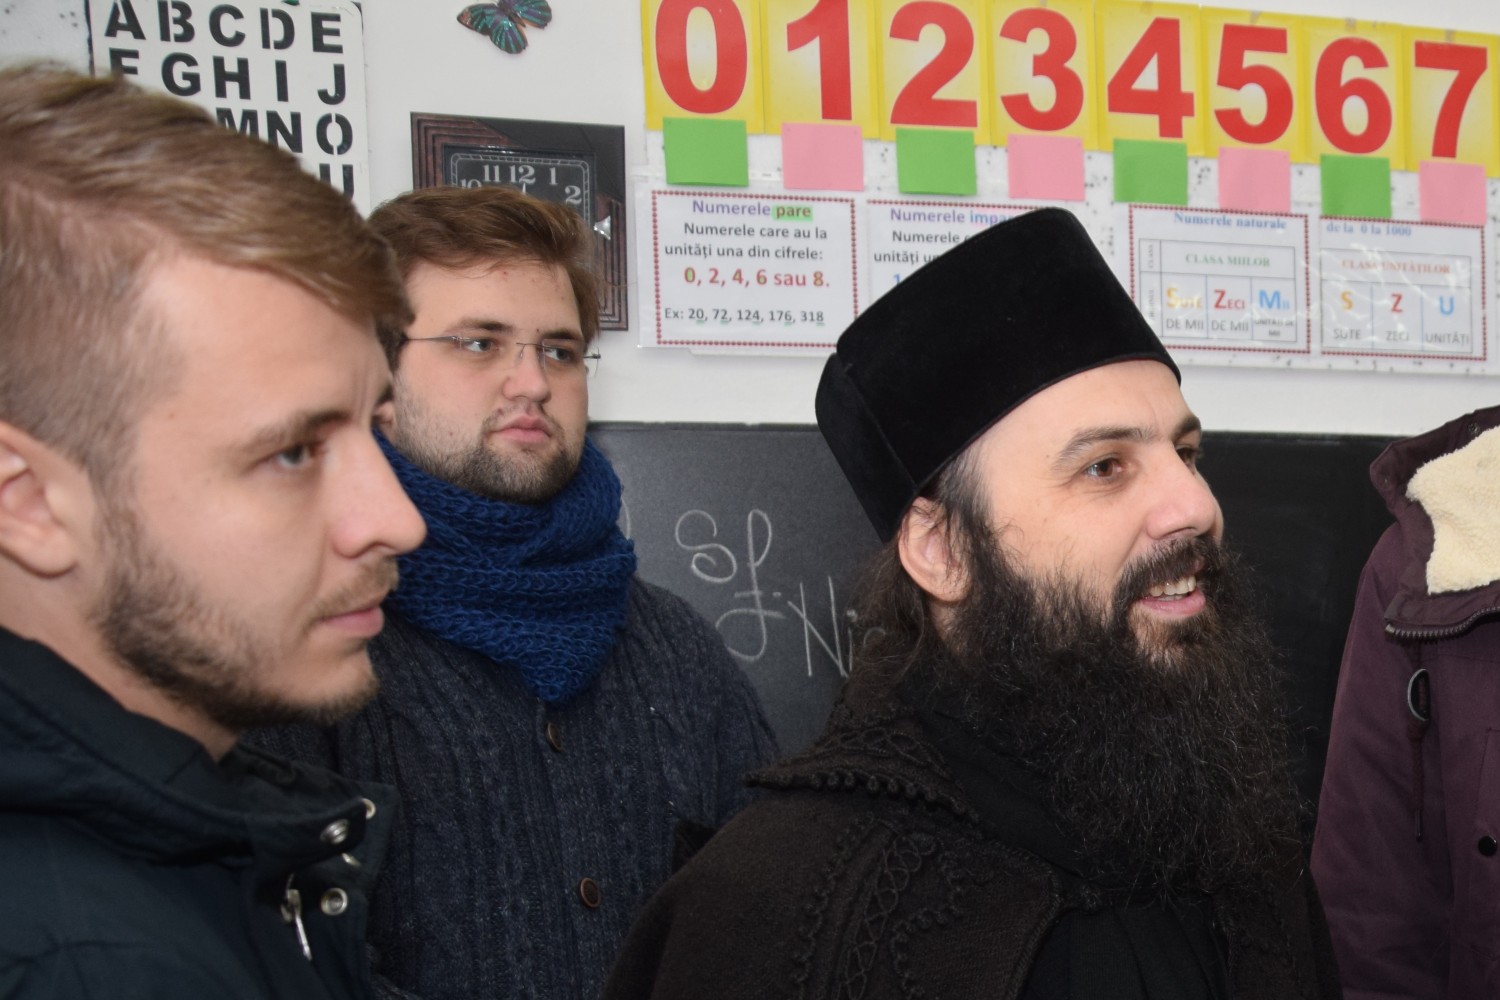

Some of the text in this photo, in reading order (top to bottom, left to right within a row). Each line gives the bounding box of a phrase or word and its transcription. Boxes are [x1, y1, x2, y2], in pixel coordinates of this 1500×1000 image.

[104, 0, 343, 54] A B C D E
[161, 52, 201, 97] G
[212, 55, 251, 100] H
[275, 60, 289, 102] I
[317, 64, 346, 105] J
[655, 0, 748, 114] 0
[787, 0, 852, 121] 1
[889, 0, 978, 128] 2
[999, 7, 1085, 131] 3
[1107, 17, 1195, 139] 4
[1213, 23, 1294, 145] 5
[1315, 36, 1393, 155] 6
[1414, 40, 1488, 159] 7
[266, 110, 303, 154] N
[316, 113, 353, 155] O
[509, 164, 536, 184] 12
[549, 167, 558, 186] 1
[565, 185, 582, 205] 2
[692, 200, 811, 219] Numerele pare
[890, 208, 965, 224] Numerele
[1174, 212, 1287, 229] Numerele naturale
[1326, 222, 1412, 237] de la 0 la 1000
[684, 223, 828, 240] Numerele care au la
[892, 230, 960, 244] Numerele
[717, 246, 744, 258] una
[748, 245, 770, 259] din
[774, 246, 823, 260] cifrele:
[1185, 253, 1224, 265] CLASA
[684, 267, 830, 287] 0, 2, 4, 6 sau 8.
[1214, 289, 1245, 310] ZECI
[1340, 290, 1354, 311] S
[1391, 293, 1403, 313] Z
[1439, 295, 1454, 316] U
[664, 308, 824, 323] Ex: 20, 72, 124, 176, 318
[1166, 318, 1181, 330] DE
[1211, 320, 1249, 332] DE MII
